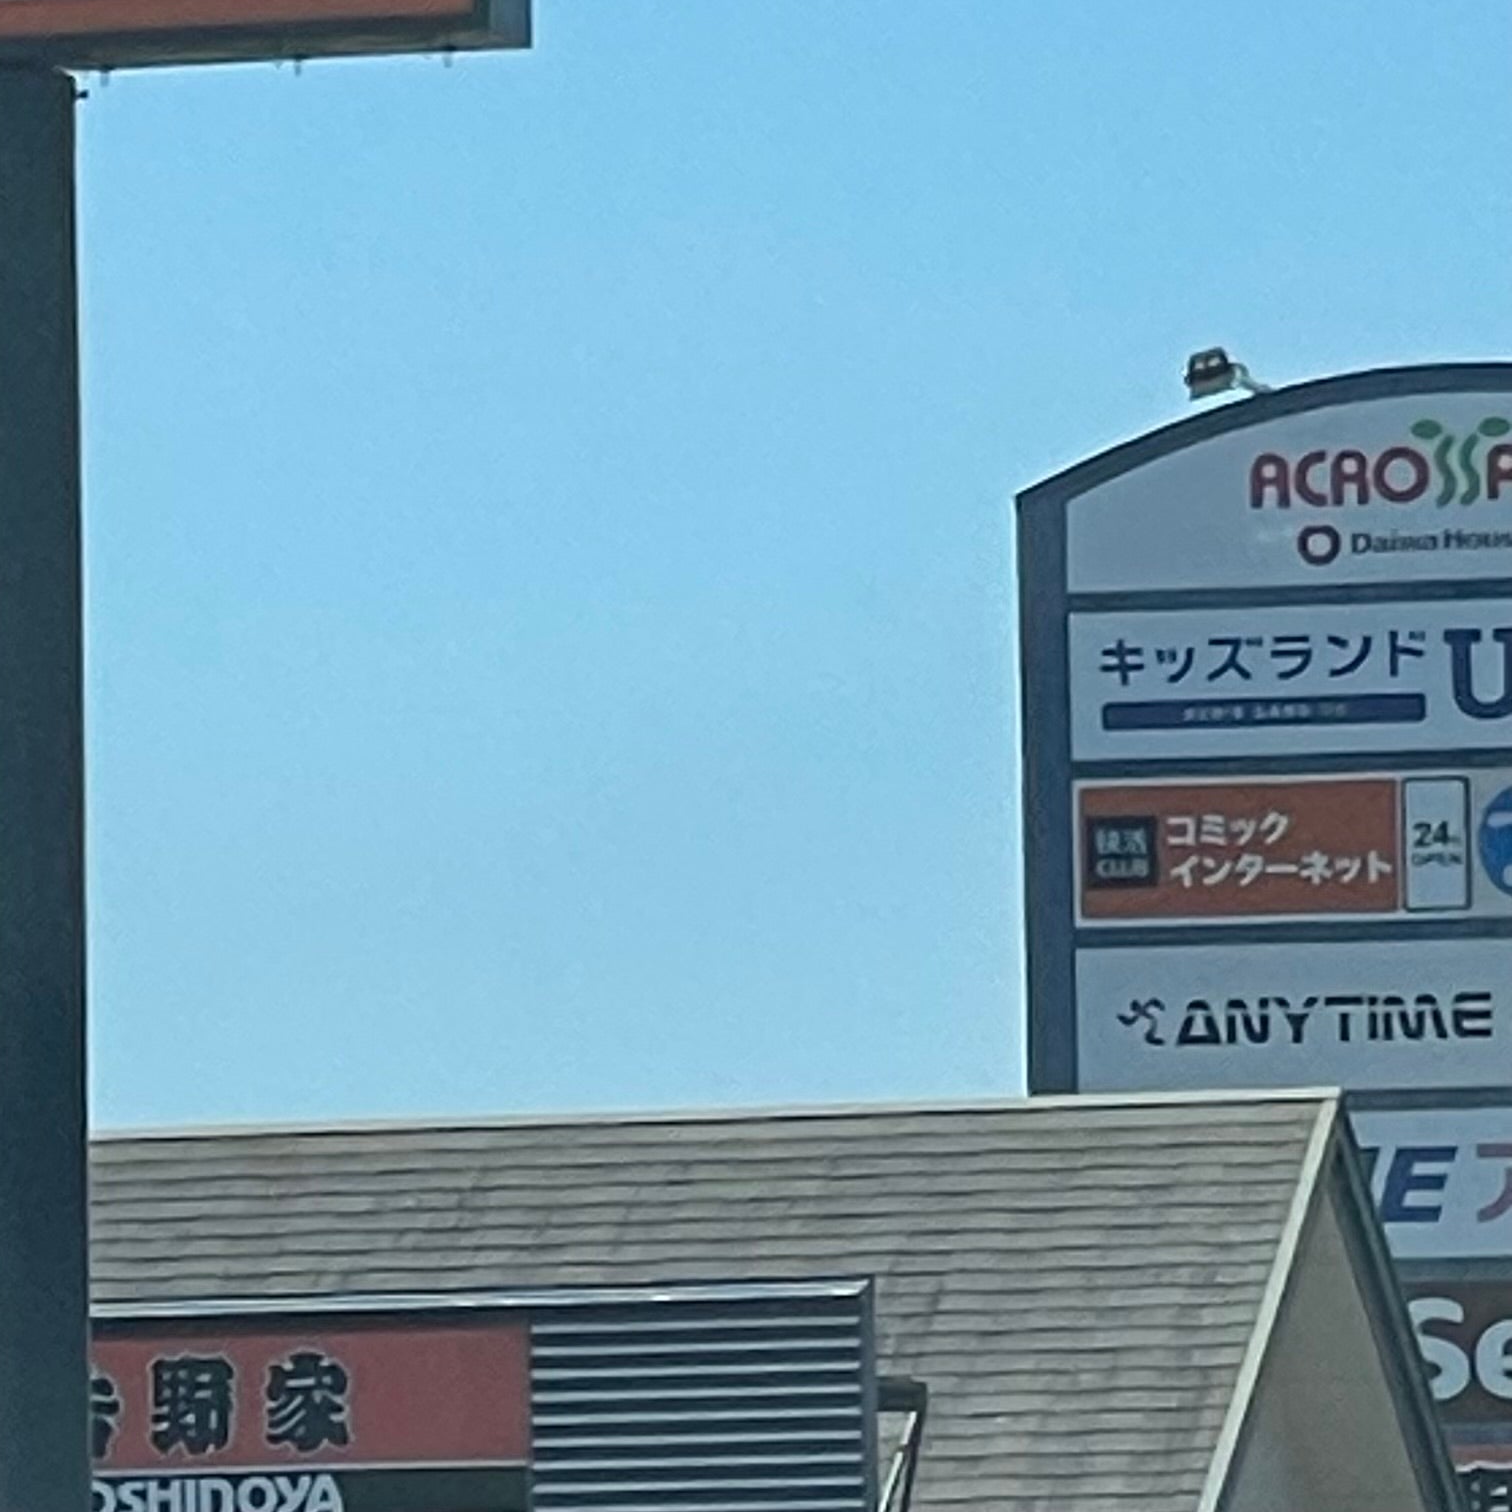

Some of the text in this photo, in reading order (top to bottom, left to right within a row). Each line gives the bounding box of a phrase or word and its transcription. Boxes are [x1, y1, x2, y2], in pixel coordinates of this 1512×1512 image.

[1099, 629, 1426, 686] キッズランド
[1166, 811, 1288, 846] コミック
[1169, 848, 1393, 888] インターネット
[1176, 991, 1492, 1047] ANYTIME
[91, 1474, 346, 1512] OSHINOYA
